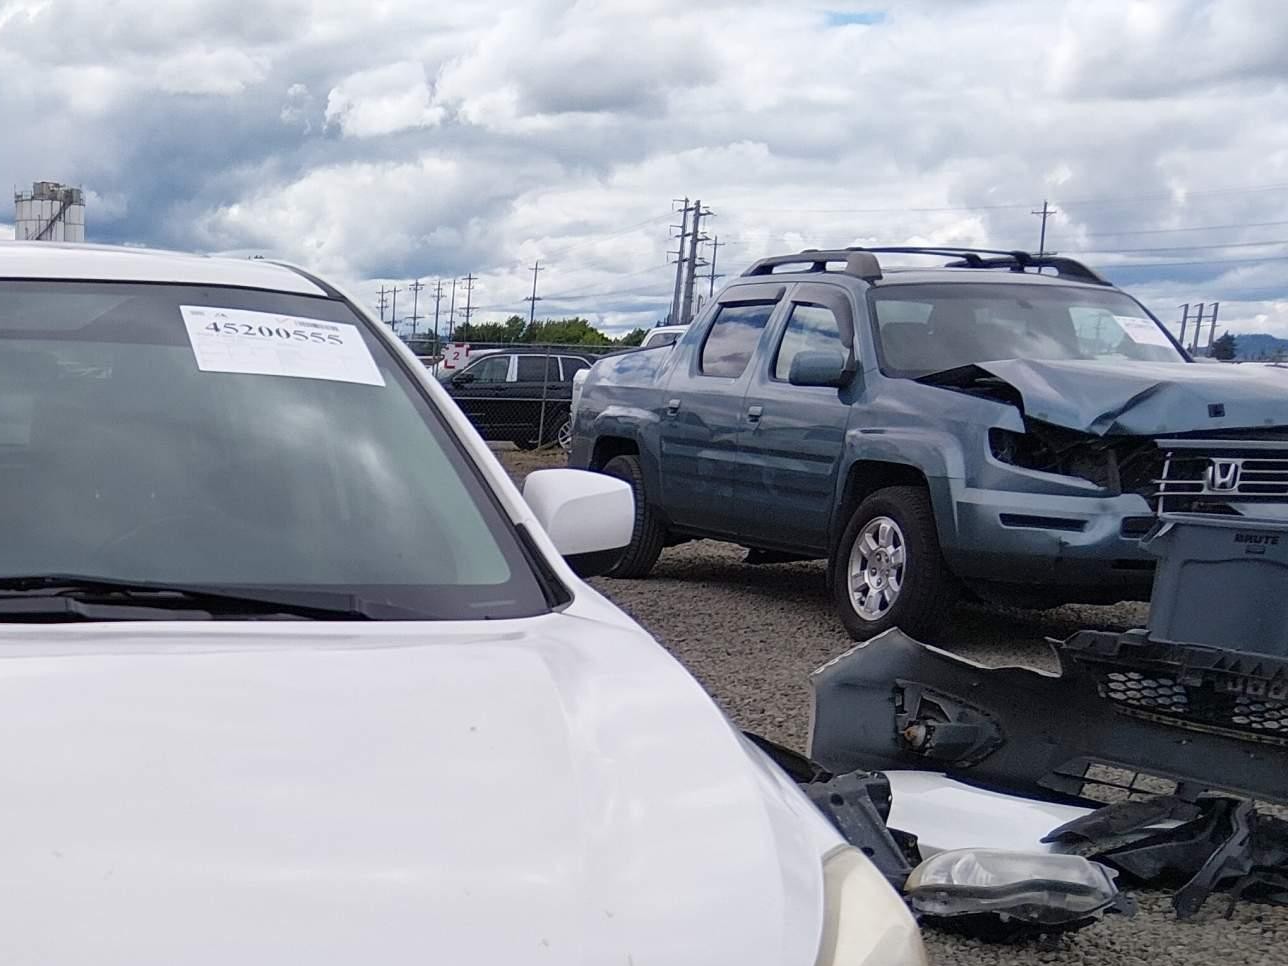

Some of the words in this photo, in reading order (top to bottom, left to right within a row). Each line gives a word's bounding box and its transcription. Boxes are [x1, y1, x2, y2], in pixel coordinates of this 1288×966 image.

[205, 321, 344, 345] 45200555
[453, 351, 460, 361] 2
[1233, 533, 1281, 545] BRUTE
